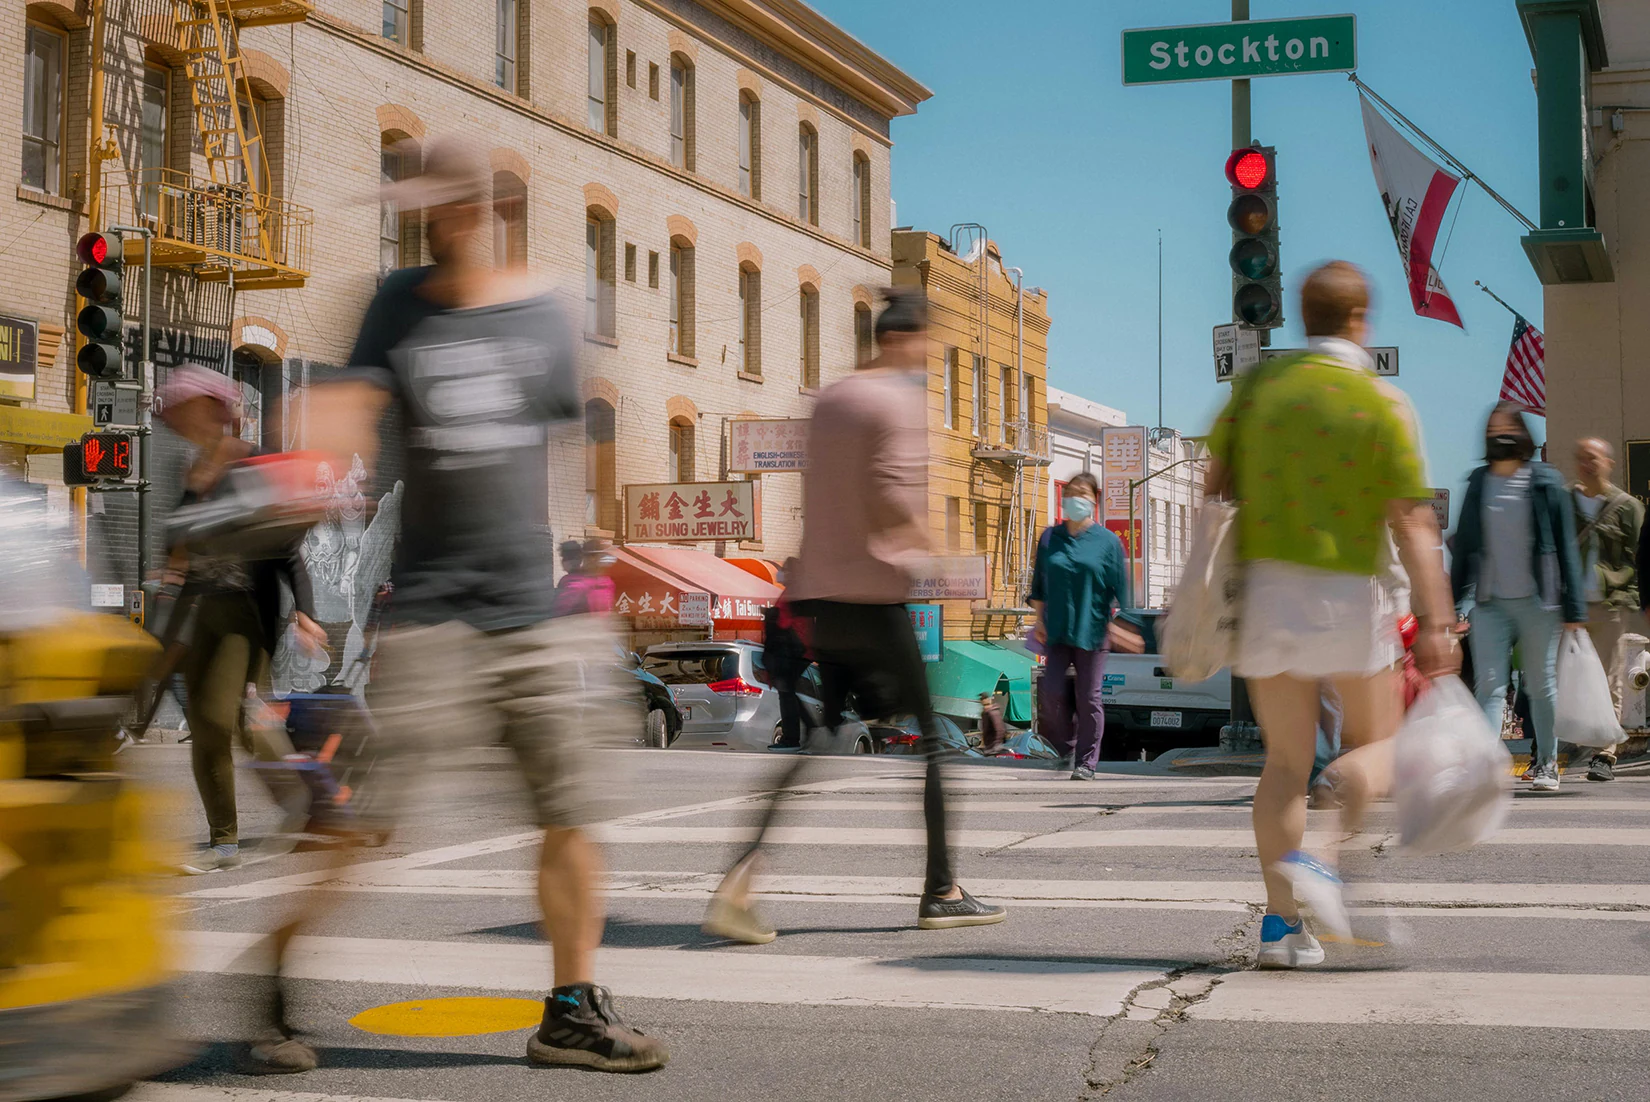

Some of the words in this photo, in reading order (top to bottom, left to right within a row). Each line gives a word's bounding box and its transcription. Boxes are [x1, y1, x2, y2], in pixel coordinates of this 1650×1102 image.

[1149, 34, 1329, 70] Stockton
[113, 441, 129, 469] 12
[754, 460, 796, 468] TRANSLATION
[633, 523, 653, 538] TAI
[655, 522, 689, 537] SUNG
[691, 520, 749, 536] JEWELRY
[923, 579, 936, 587] AN
[938, 577, 982, 588] COMPANY
[680, 594, 689, 602] NO
[690, 594, 708, 602] PARKING
[735, 599, 747, 616] Tai
